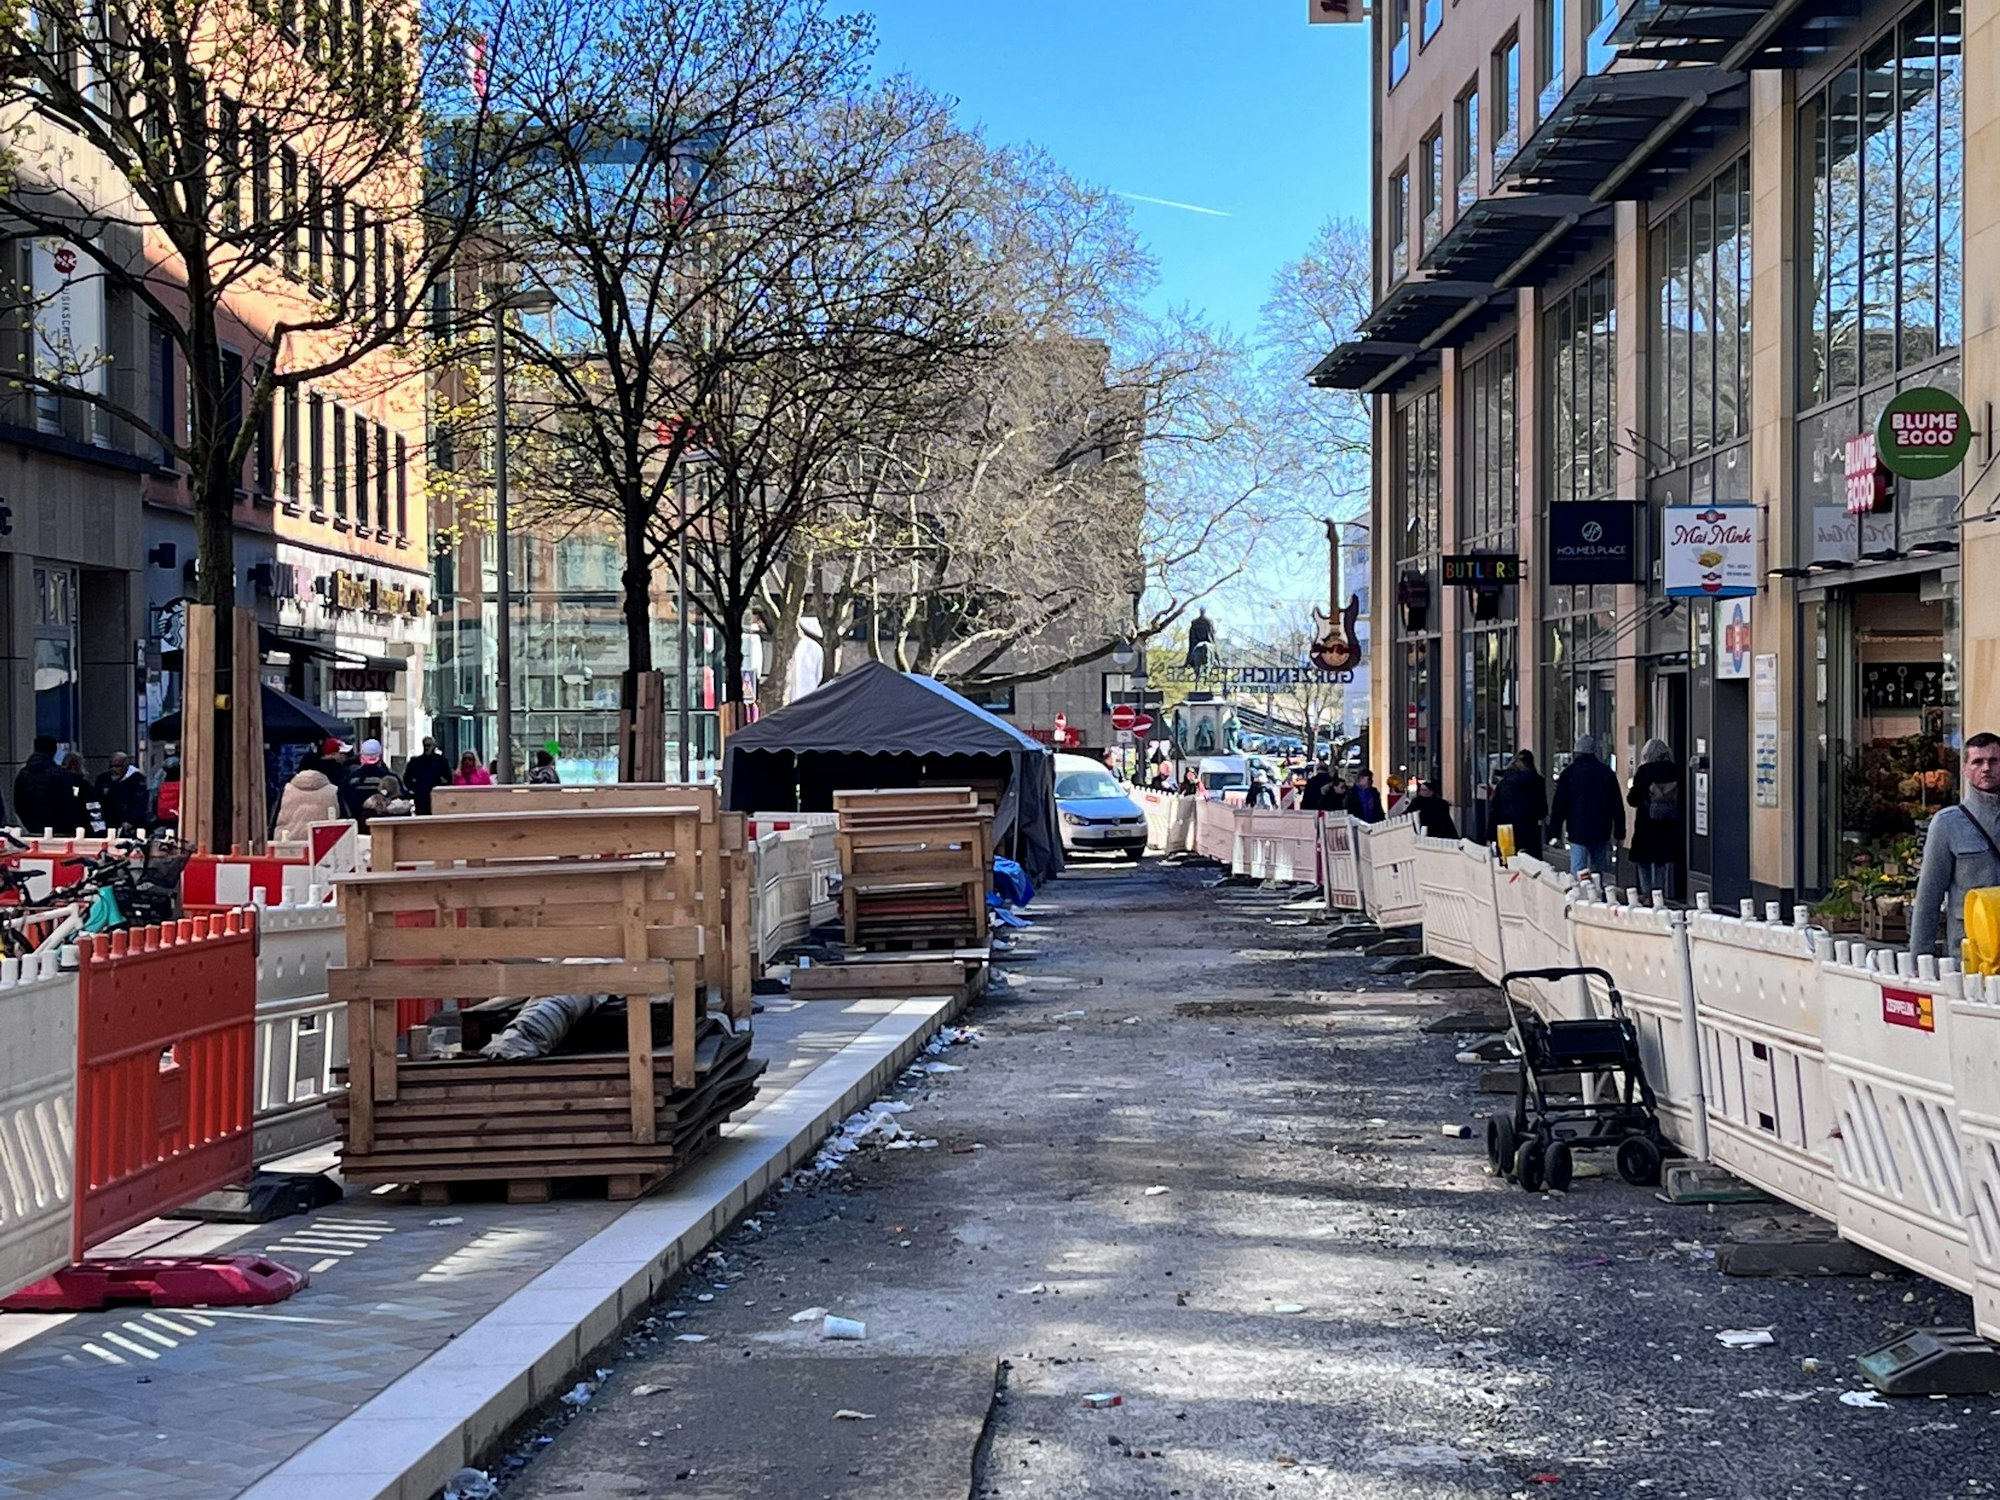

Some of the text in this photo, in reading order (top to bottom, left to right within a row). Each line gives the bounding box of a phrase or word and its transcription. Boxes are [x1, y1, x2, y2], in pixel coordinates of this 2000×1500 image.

[1892, 414, 1957, 429] BLUME
[1897, 430, 1953, 445] 2000
[1845, 434, 1877, 476] BLUME
[1846, 473, 1875, 511] 2000
[1671, 525, 1708, 546] Mai
[1556, 545, 1627, 556] HOLMES PLACE
[1445, 561, 1515, 579] BUTLERS
[333, 670, 390, 691] KIOSK
